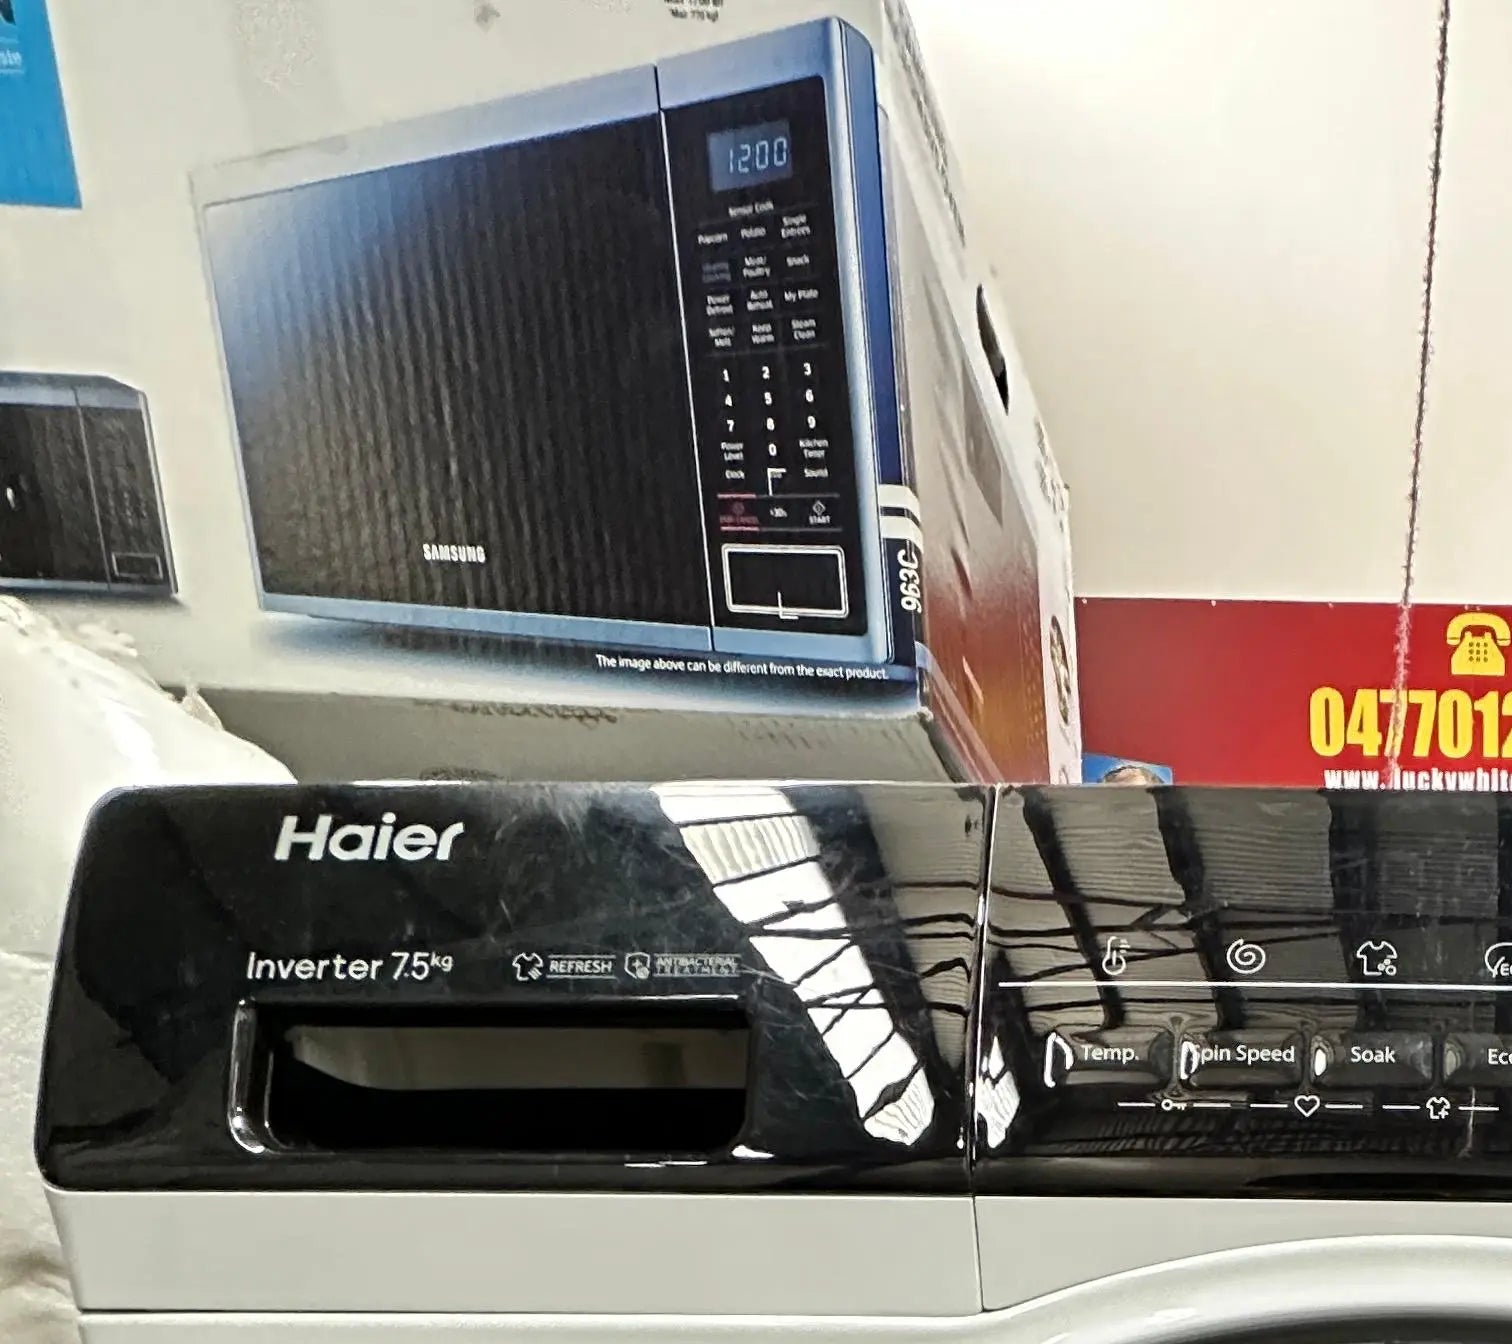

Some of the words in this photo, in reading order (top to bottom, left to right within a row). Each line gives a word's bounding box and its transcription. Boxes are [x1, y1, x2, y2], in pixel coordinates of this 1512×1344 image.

[723, 369, 730, 382] 1
[762, 366, 770, 379] 2
[803, 362, 812, 376] 3
[725, 394, 732, 406] 4
[764, 392, 772, 405] 5
[805, 389, 814, 402] 6
[727, 419, 734, 432] 7
[766, 417, 775, 431] 8
[808, 415, 816, 429] 9
[768, 443, 777, 456] 0
[423, 543, 486, 563] SAMSUNG
[897, 549, 922, 614] 963C
[596, 654, 617, 667] The
[619, 655, 651, 672] image
[653, 658, 685, 671] above
[687, 660, 706, 672] can
[707, 659, 721, 673] be
[723, 660, 768, 675] different
[769, 662, 795, 676] from
[796, 664, 814, 677] the
[816, 666, 844, 679] exact
[274, 812, 465, 861] Haier
[246, 951, 384, 980] Inverter
[550, 960, 613, 973] REFRESH
[1082, 1047, 1140, 1069] Temp.
[1236, 1044, 1295, 1066] Speed
[1351, 1046, 1396, 1064] Soak
